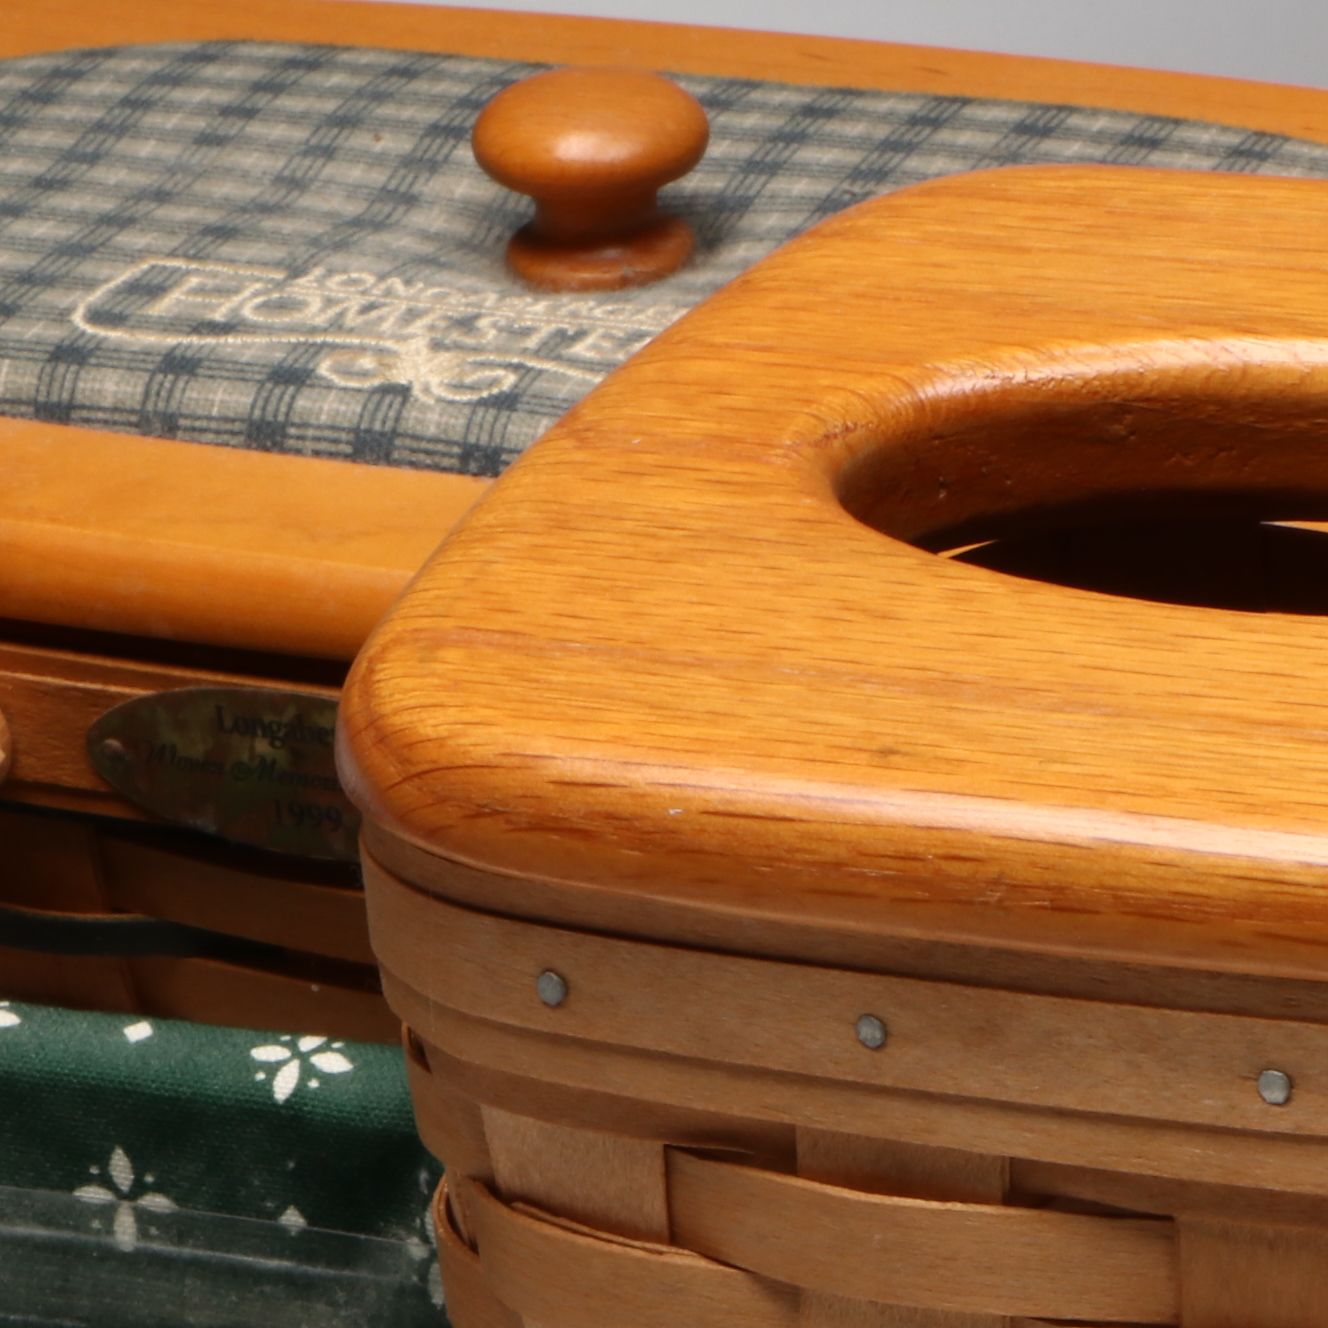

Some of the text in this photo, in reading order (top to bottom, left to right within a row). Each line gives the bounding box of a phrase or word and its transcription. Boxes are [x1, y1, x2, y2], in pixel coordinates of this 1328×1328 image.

[146, 277, 643, 360] HOMESTE
[290, 266, 682, 324] LONGABERGE
[274, 799, 343, 833] 1999
